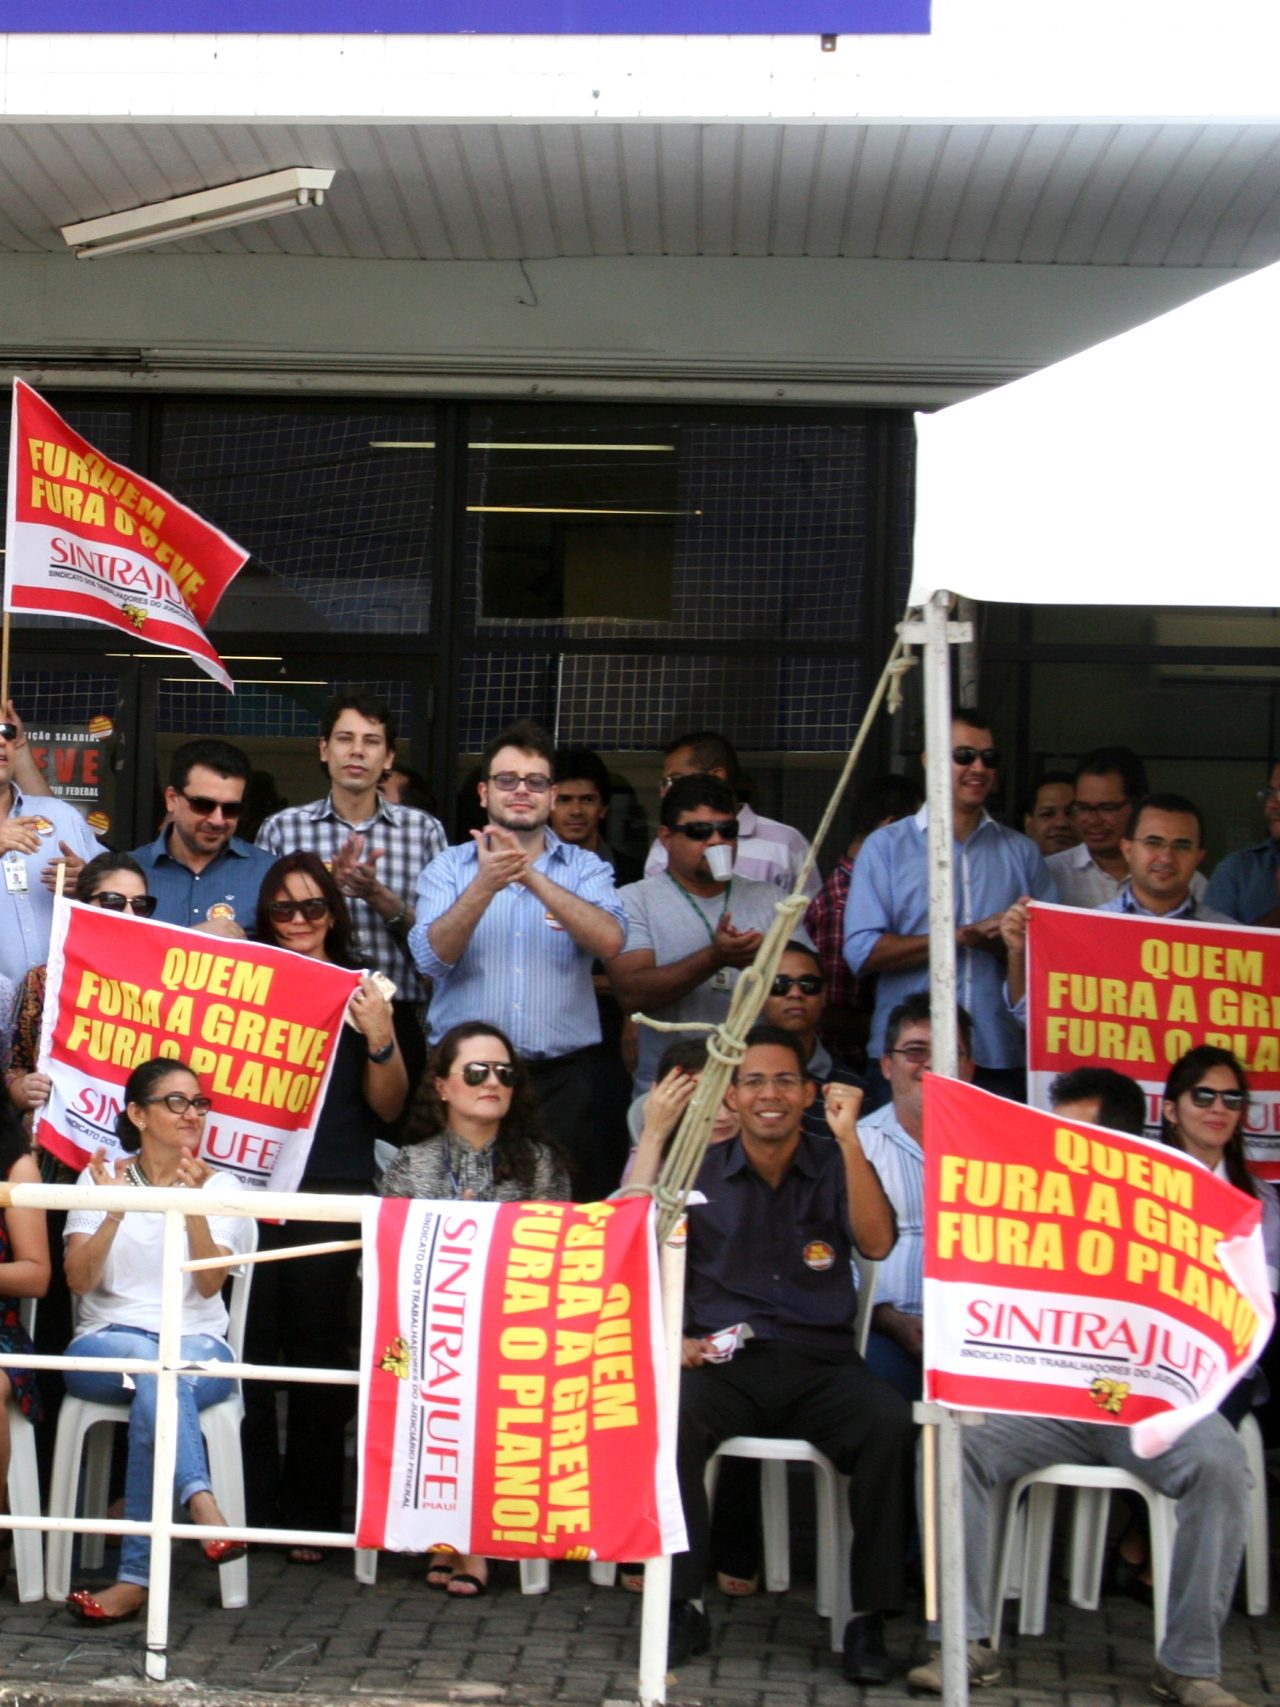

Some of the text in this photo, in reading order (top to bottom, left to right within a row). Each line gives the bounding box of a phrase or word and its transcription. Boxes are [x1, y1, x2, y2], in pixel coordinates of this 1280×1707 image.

[30, 475, 106, 527] FURA
[65, 787, 99, 796] FEDERAL
[161, 947, 275, 1006] QUEM
[1047, 971, 1159, 1021] FURA
[1166, 984, 1199, 1024] A
[1140, 938, 1263, 987] QUEM
[75, 970, 329, 1074] FURA A GREVE,
[1046, 1015, 1156, 1064] FURA
[65, 1015, 154, 1070] FURA
[190, 1047, 320, 1114] PLANO!
[100, 1136, 117, 1147] DOS
[1054, 1127, 1194, 1211] QUEM
[939, 1154, 1075, 1217] FURA
[1084, 1181, 1122, 1230] A
[936, 1210, 1261, 1357] FURA O PLANO!
[401, 1212, 433, 1509] SINDICATO DOS TRABALHADORES DO JUDICIÁRIO FEDERAL
[421, 1216, 478, 1501] SINTRAJUFE
[491, 1203, 565, 1545] FURA O PLANO!
[554, 1329, 593, 1367] A
[592, 1282, 639, 1431] QUEM
[960, 1349, 1012, 1362] SINDICATO
[1014, 1355, 1037, 1366] DOS
[1039, 1357, 1131, 1376] TRABALHADORES
[1133, 1368, 1151, 1379] DO
[541, 1375, 591, 1544] GREVE,
